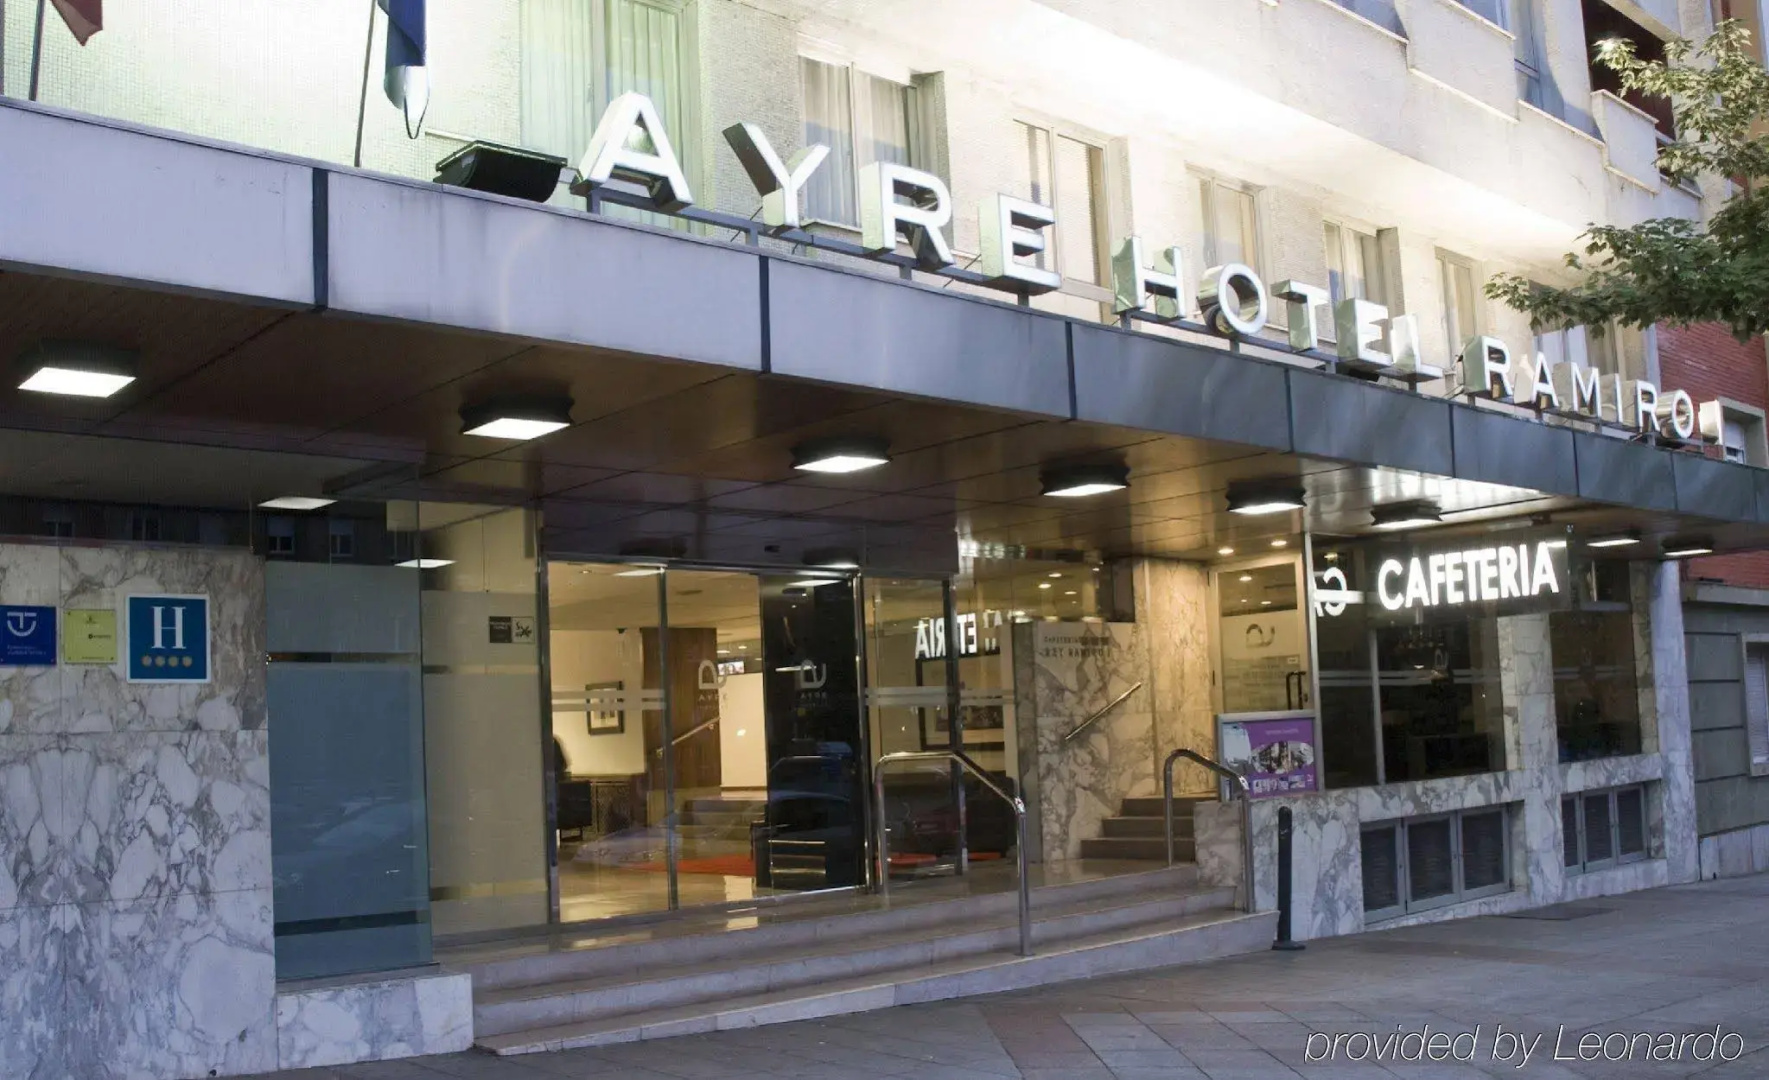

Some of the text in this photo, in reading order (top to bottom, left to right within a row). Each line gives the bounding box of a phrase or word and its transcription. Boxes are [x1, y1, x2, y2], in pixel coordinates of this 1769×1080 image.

[572, 91, 1062, 294] AYRE
[1112, 236, 1443, 381] HOTEL
[1463, 335, 1694, 440] RAMIRO
[1378, 541, 1560, 611] CAFETERIA
[151, 606, 187, 649] H
